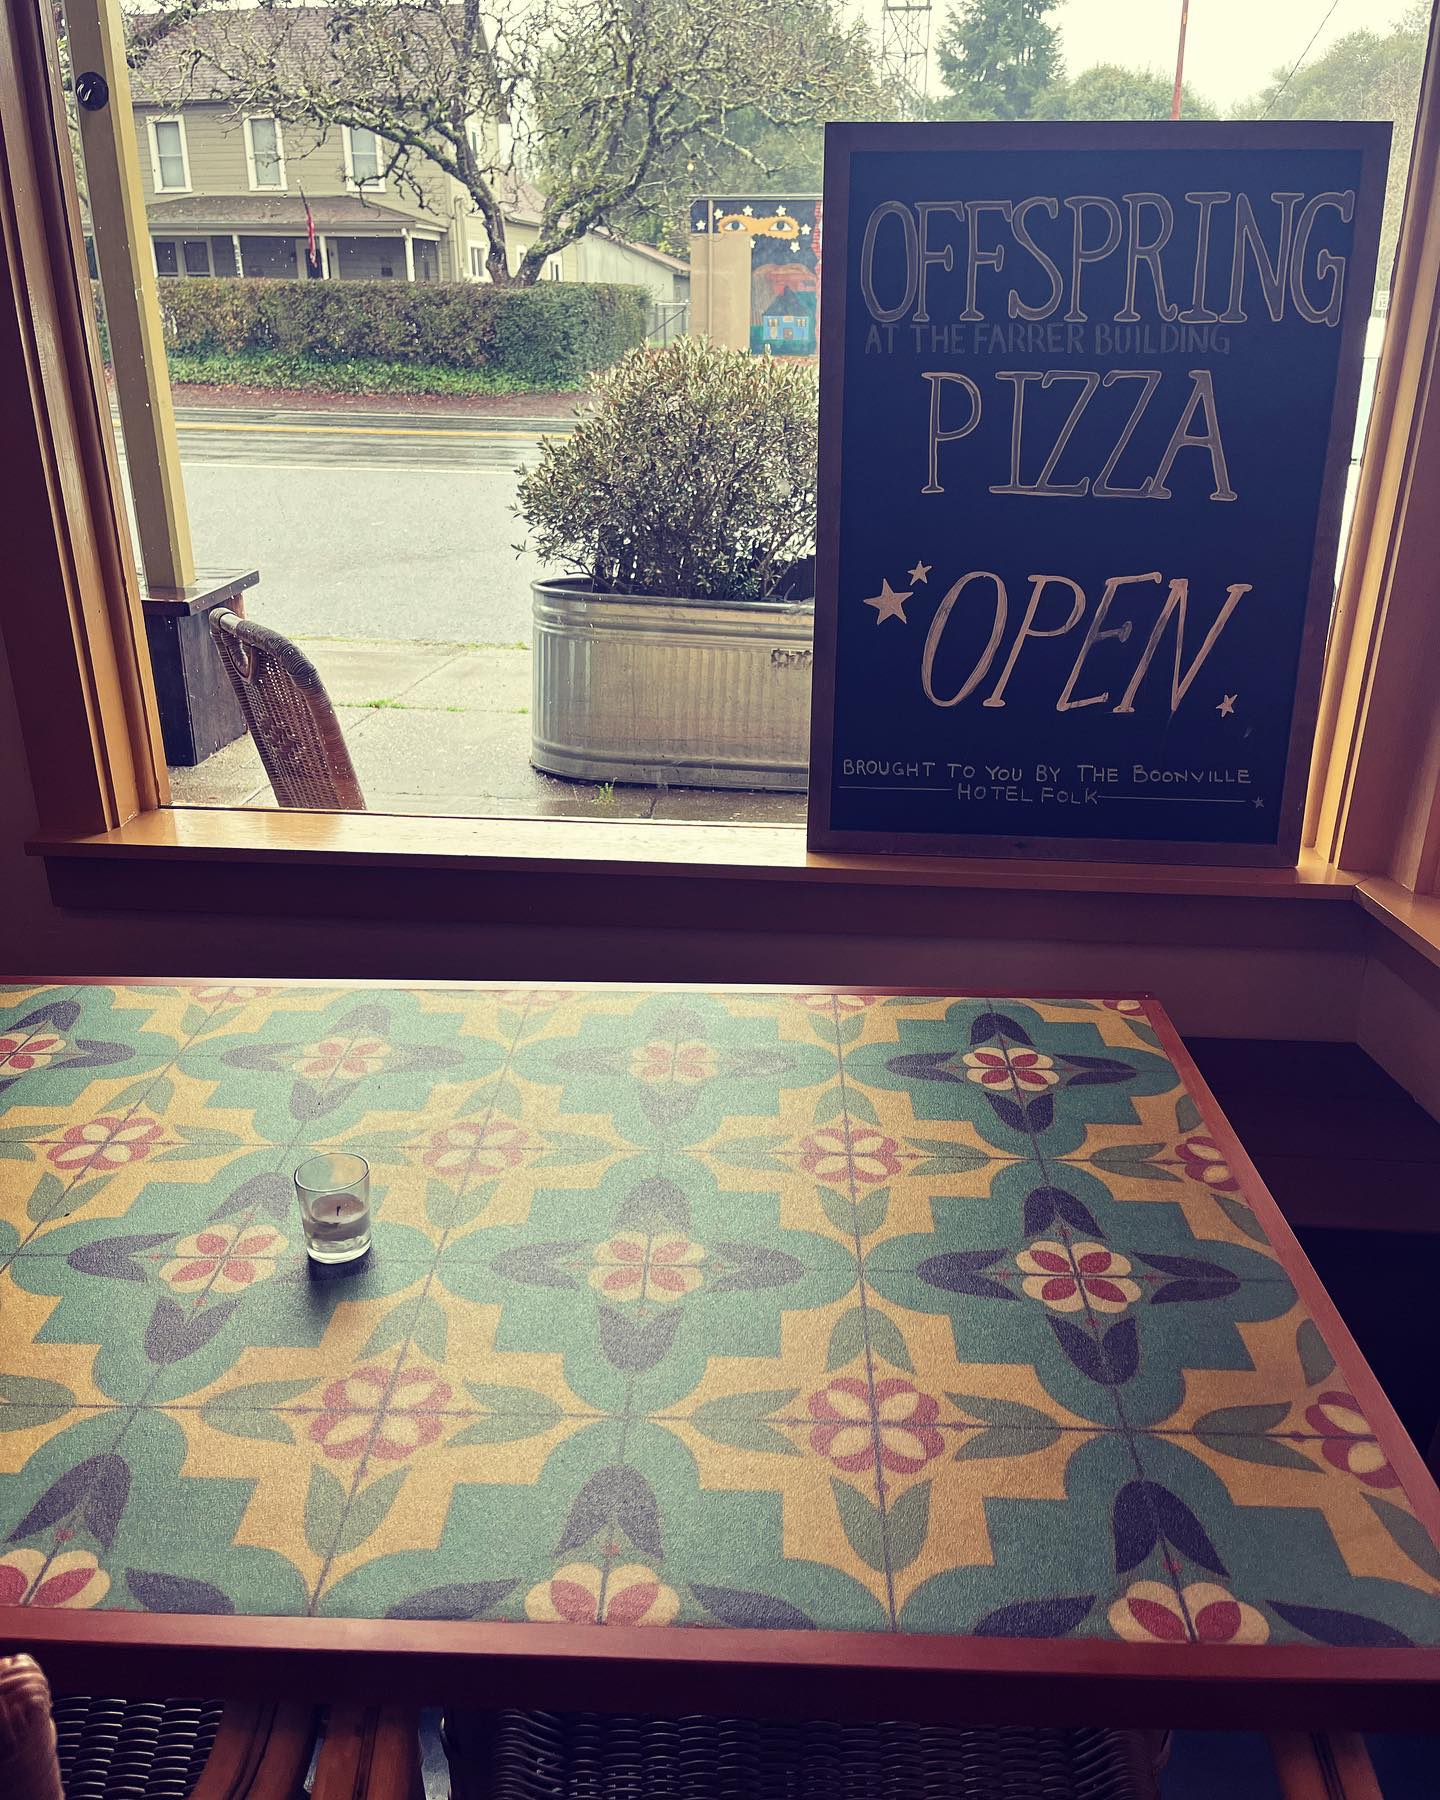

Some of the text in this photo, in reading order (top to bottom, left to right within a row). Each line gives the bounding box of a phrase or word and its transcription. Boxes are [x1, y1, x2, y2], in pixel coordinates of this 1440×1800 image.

[860, 191, 1355, 327] OFFSPRING
[865, 324, 1231, 355] AT THE FARRER BUILDING
[921, 370, 1238, 501] PIZZA
[921, 571, 1253, 713] OPEN
[843, 759, 1251, 784] BROUGHT TO YOU BY THE BOONVILLE
[958, 783, 1098, 805] HOTEL FOLK
